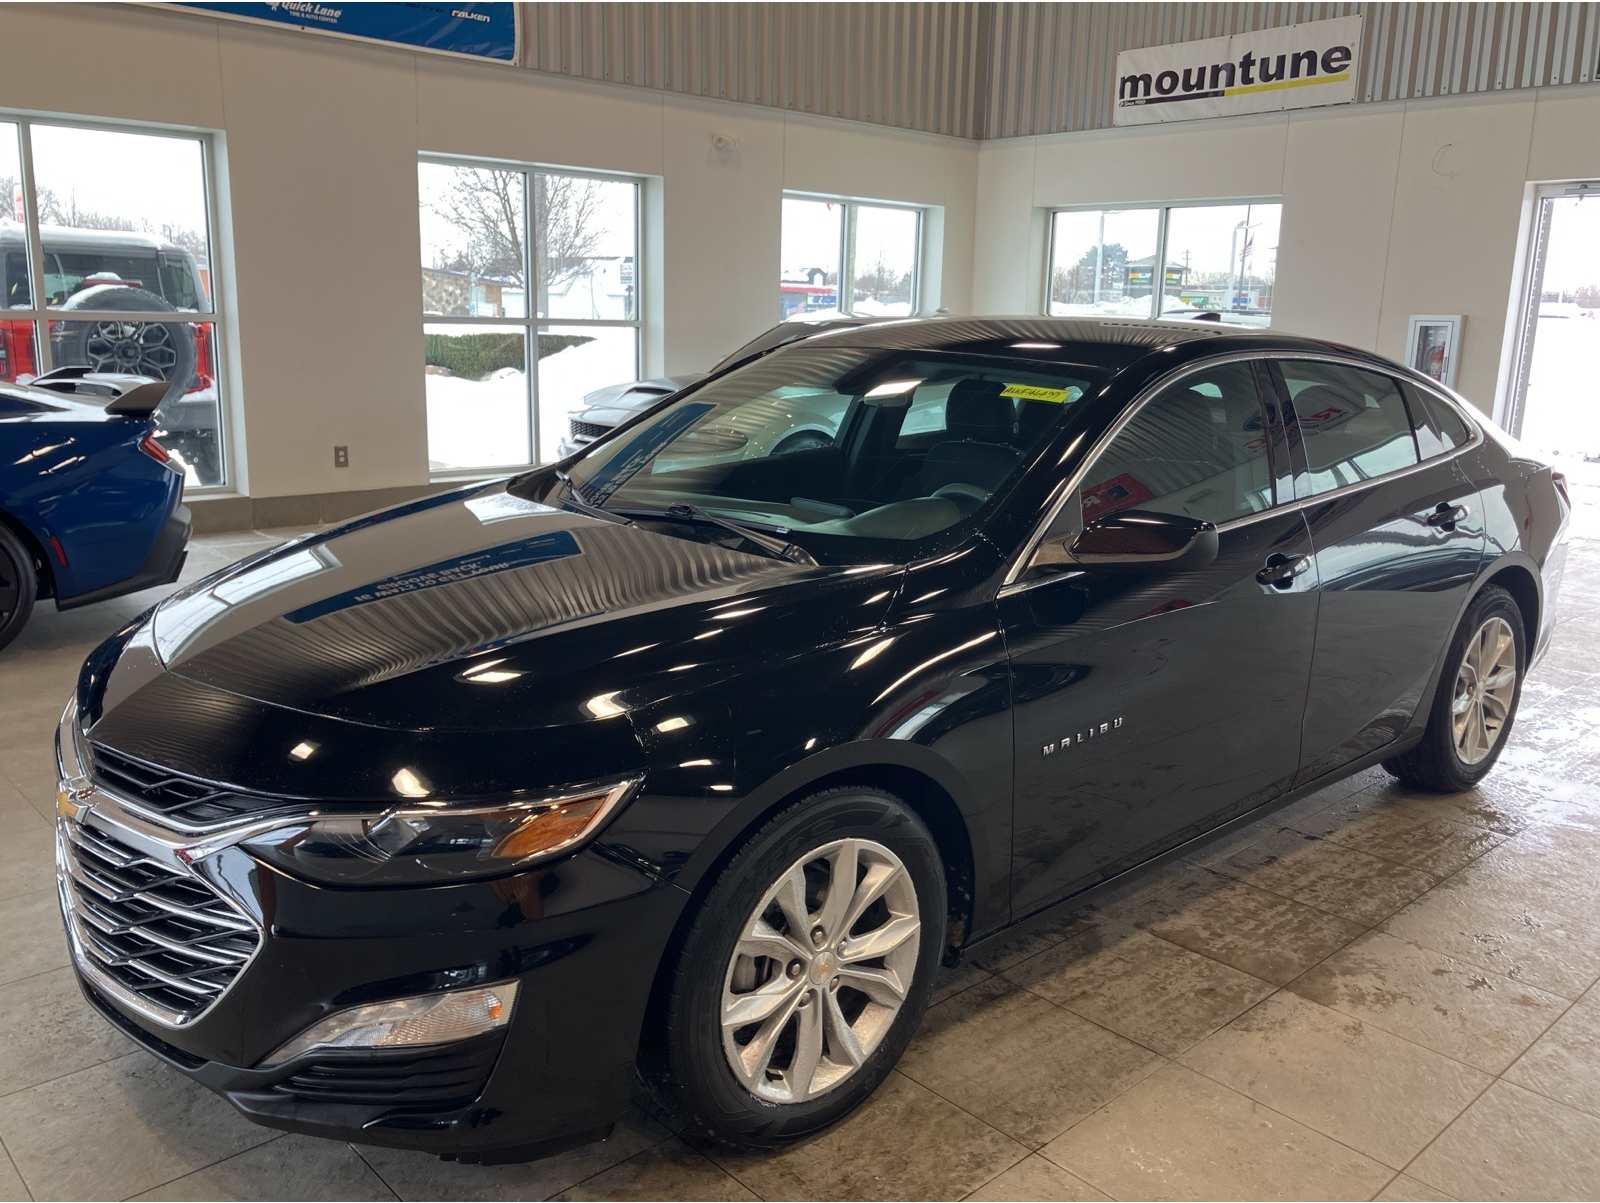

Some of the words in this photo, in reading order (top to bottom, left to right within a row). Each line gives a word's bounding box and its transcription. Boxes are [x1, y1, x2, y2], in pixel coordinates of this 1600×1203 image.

[314, 4, 342, 18] Lane
[451, 9, 490, 23] FALKEN
[1119, 45, 1353, 99] mountune
[1042, 717, 1124, 756] MALIBU
